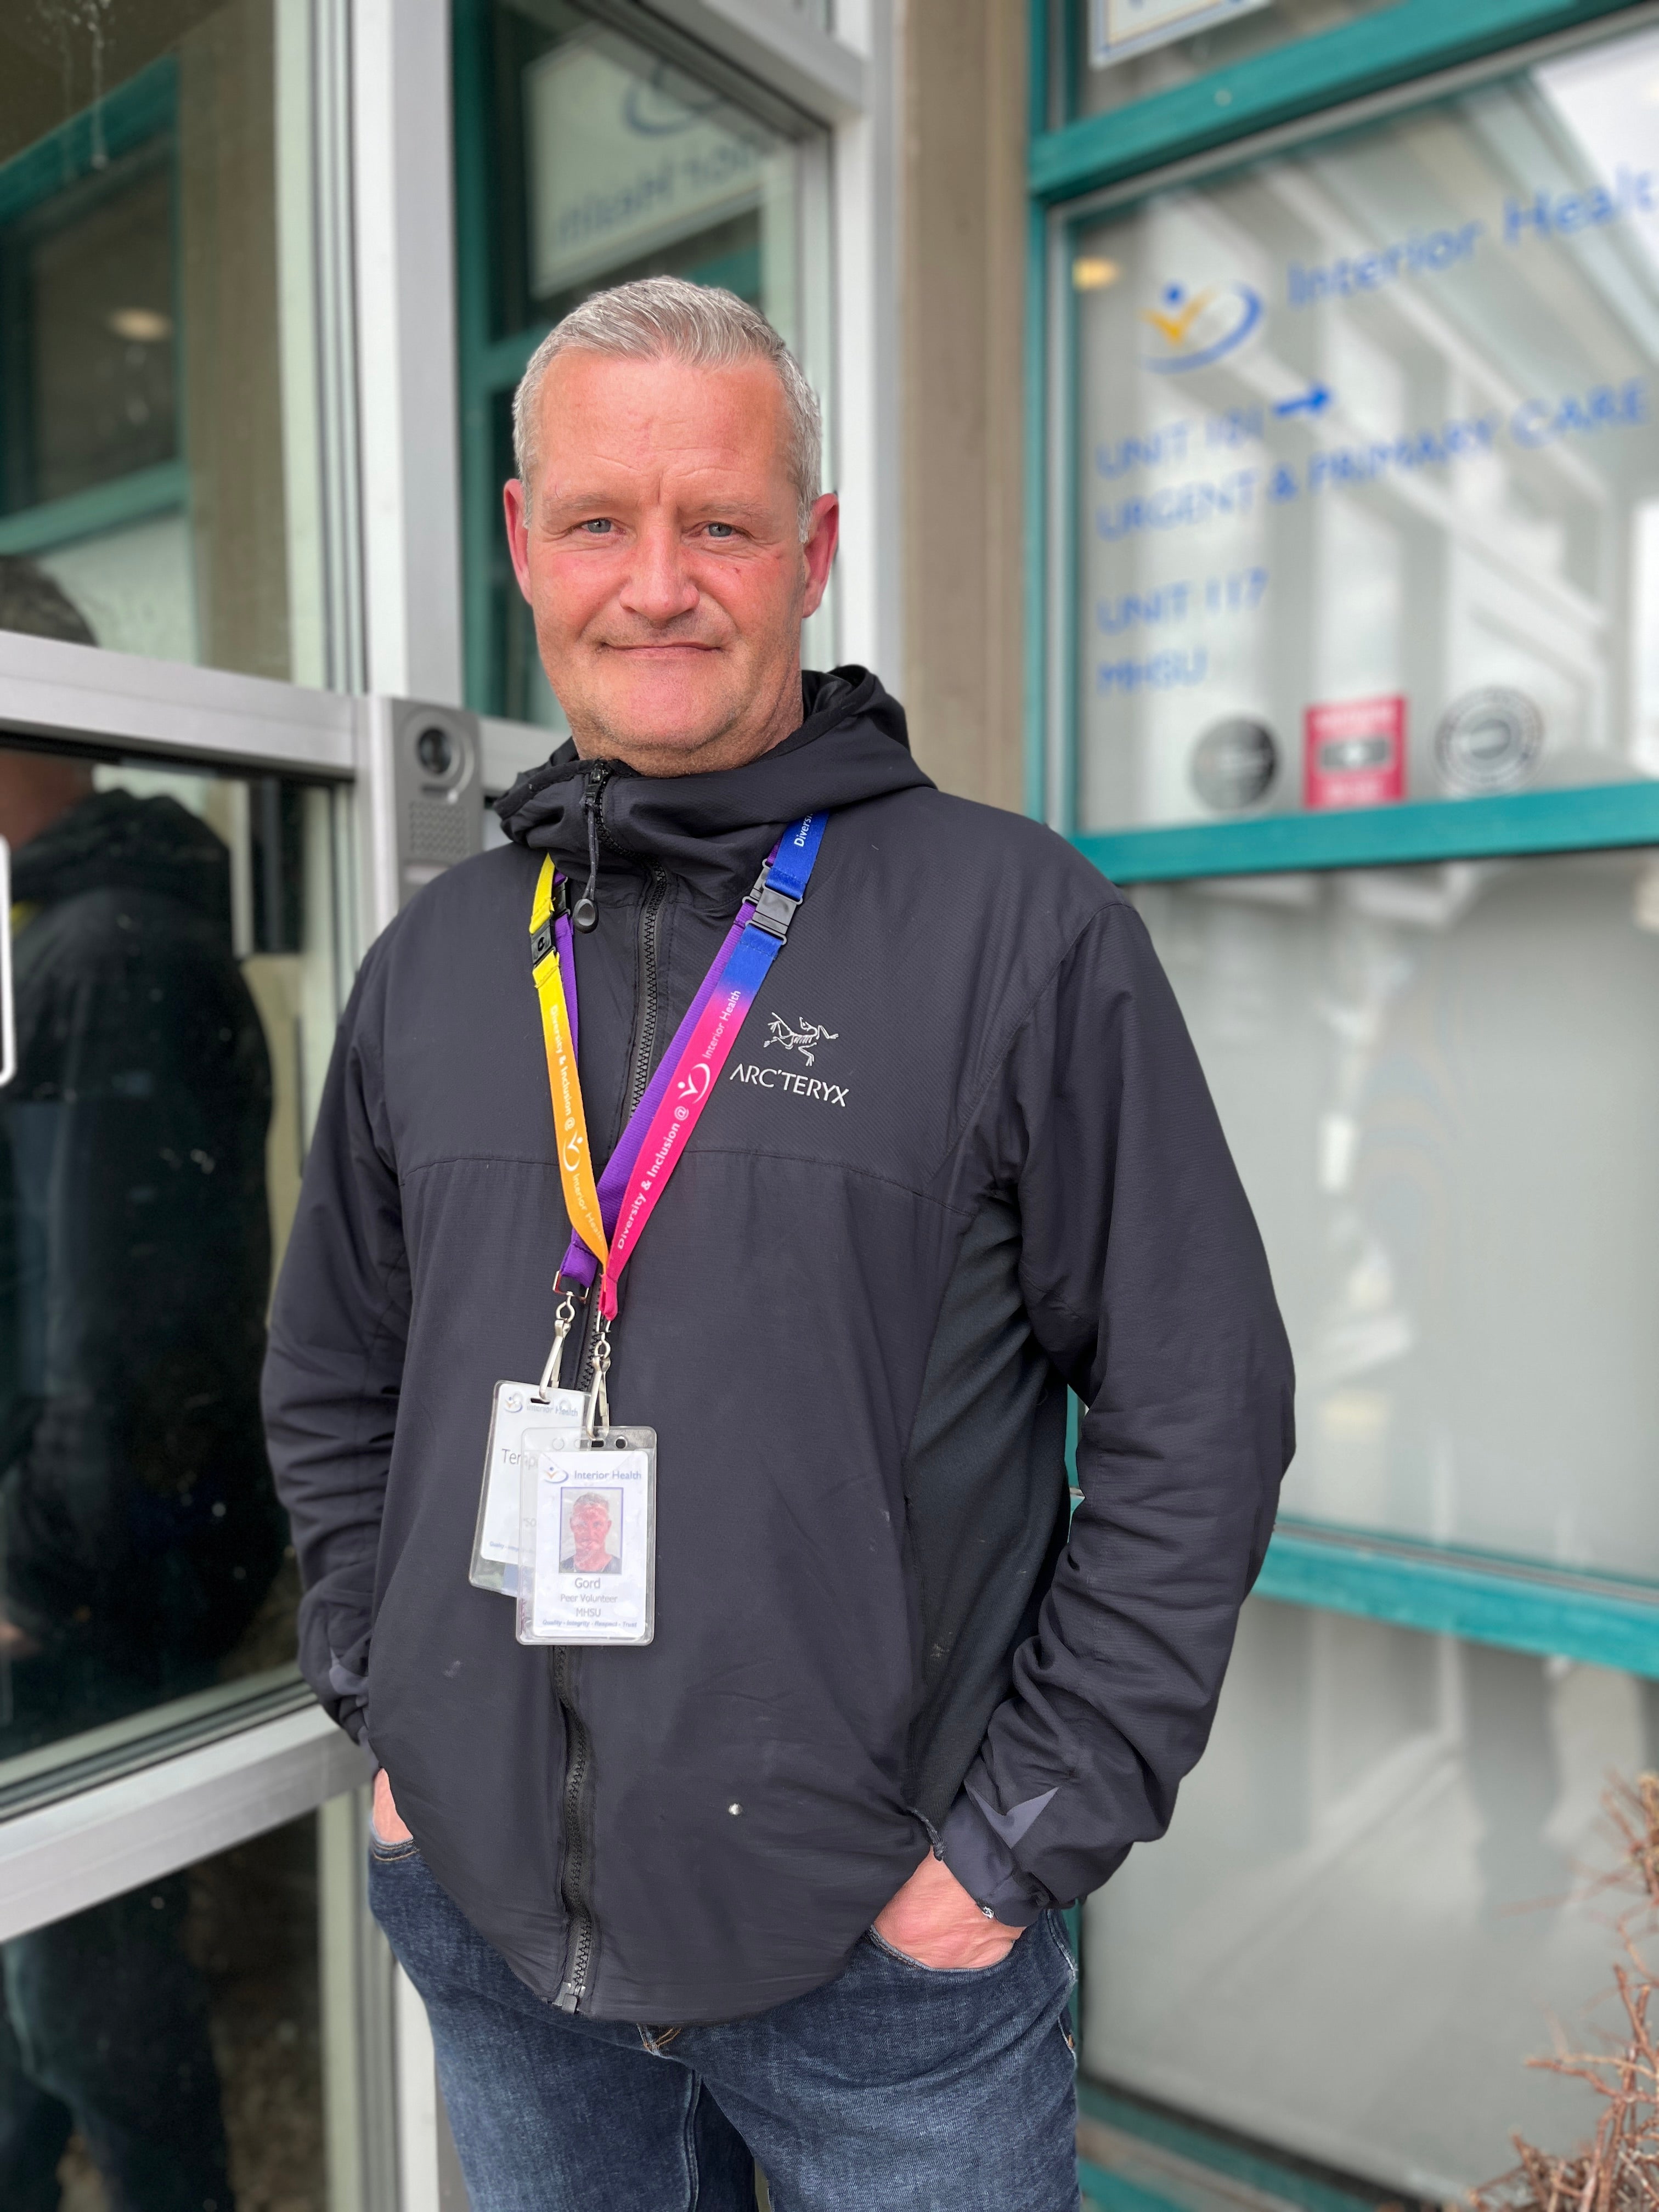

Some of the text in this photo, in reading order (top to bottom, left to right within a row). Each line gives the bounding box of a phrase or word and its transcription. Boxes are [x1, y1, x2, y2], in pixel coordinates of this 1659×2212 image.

[1288, 162, 1659, 309] Interior Healt
[1095, 467, 1257, 540] URGENT
[1308, 411, 1500, 489] PRIMARY
[1510, 382, 1647, 448] CARE
[1096, 419, 1190, 479] UNIT
[1096, 567, 1268, 635] UNIT 117
[550, 1004, 562, 1053] Diversity
[559, 1055, 567, 1065] &
[561, 1065, 572, 1116] Inclusion
[565, 1117, 575, 1131] @
[617, 990, 741, 1250] Diversity & Inclusion @ Interior Health
[573, 1173, 588, 1210] Interior
[555, 1406, 578, 1417] Health
[574, 1470, 642, 1480] Interior Health
[560, 1594, 618, 1603] Peer Volunteer
[574, 1577, 601, 1589] Gord
[575, 1607, 601, 1617] MHSU
